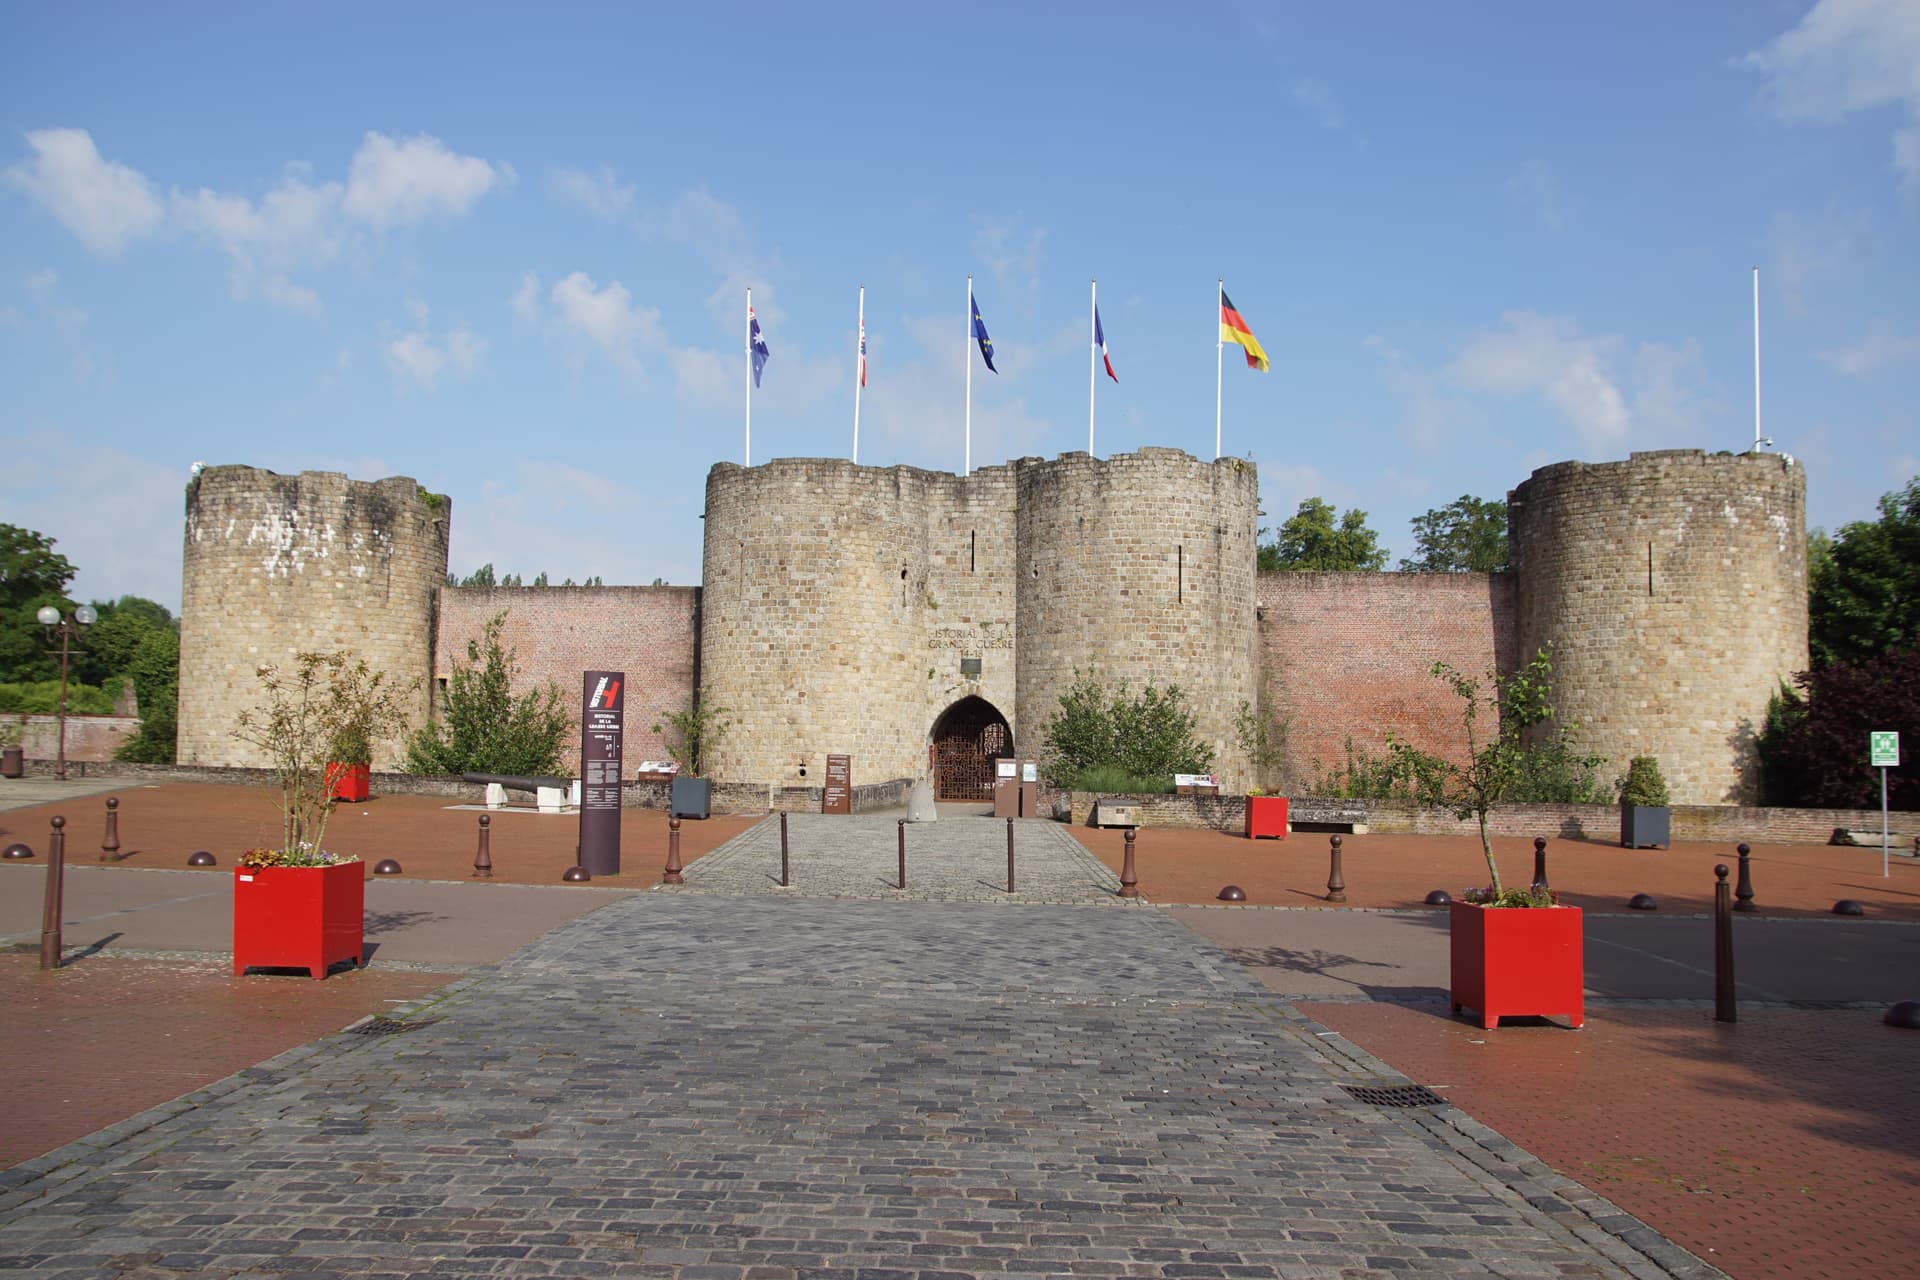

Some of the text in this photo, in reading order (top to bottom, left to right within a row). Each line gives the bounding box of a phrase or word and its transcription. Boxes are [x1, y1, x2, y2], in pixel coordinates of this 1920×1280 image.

[983, 629, 996, 639] DE
[928, 639, 1014, 649] GRANDE GUERRE
